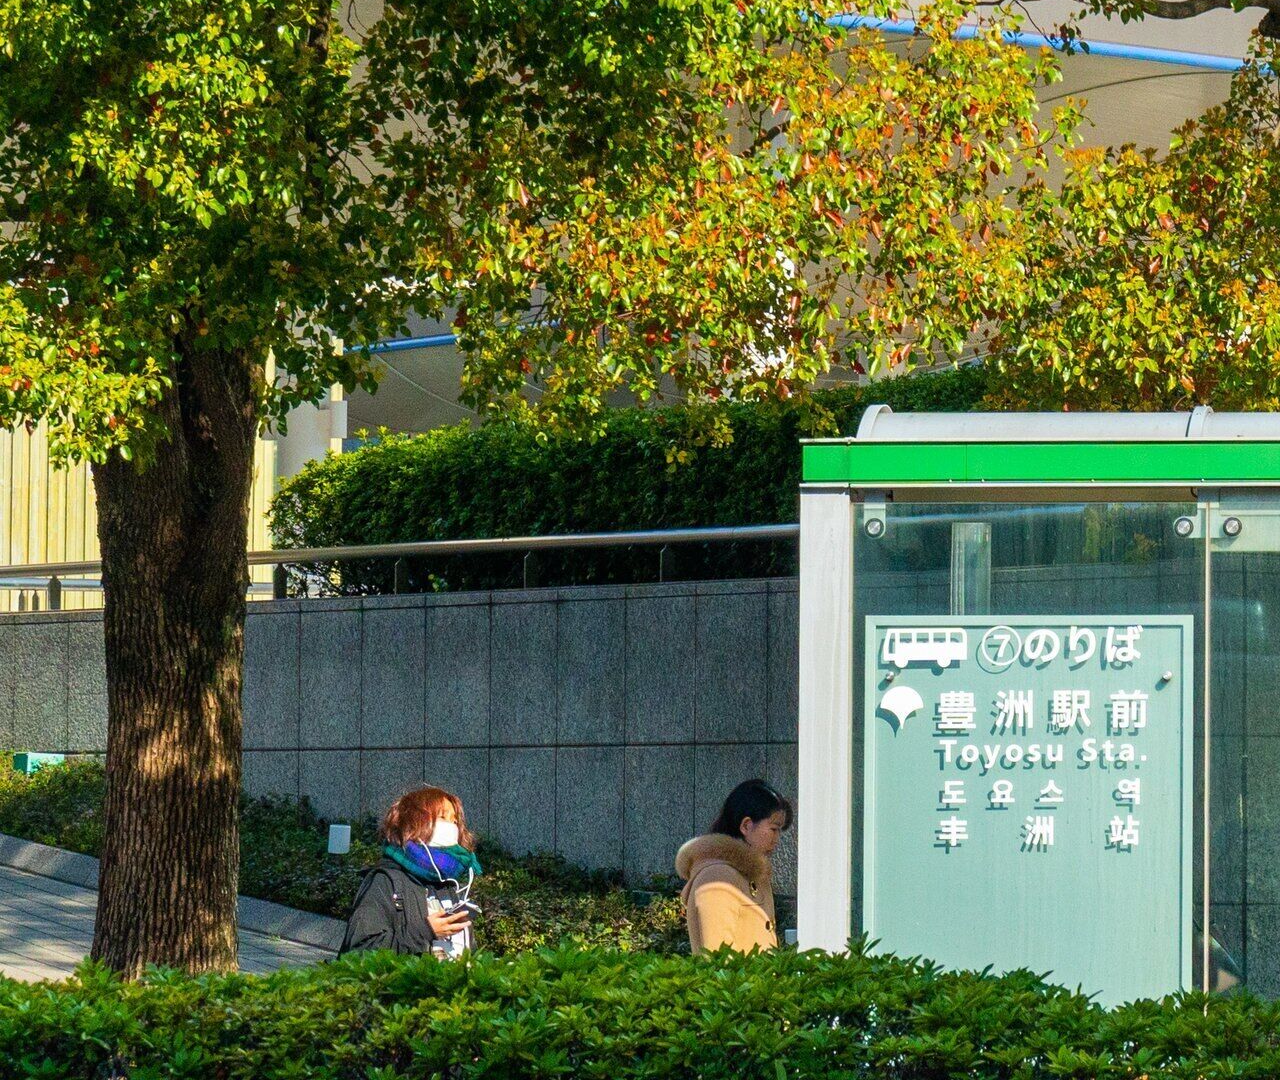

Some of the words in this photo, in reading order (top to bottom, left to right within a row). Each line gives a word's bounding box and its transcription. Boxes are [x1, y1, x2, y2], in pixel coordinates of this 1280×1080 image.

[938, 689, 1149, 729] 豊洲駅前
[939, 740, 1063, 768] Toyosu
[1082, 738, 1147, 762] Sta.
[942, 780, 1064, 803] 도요스
